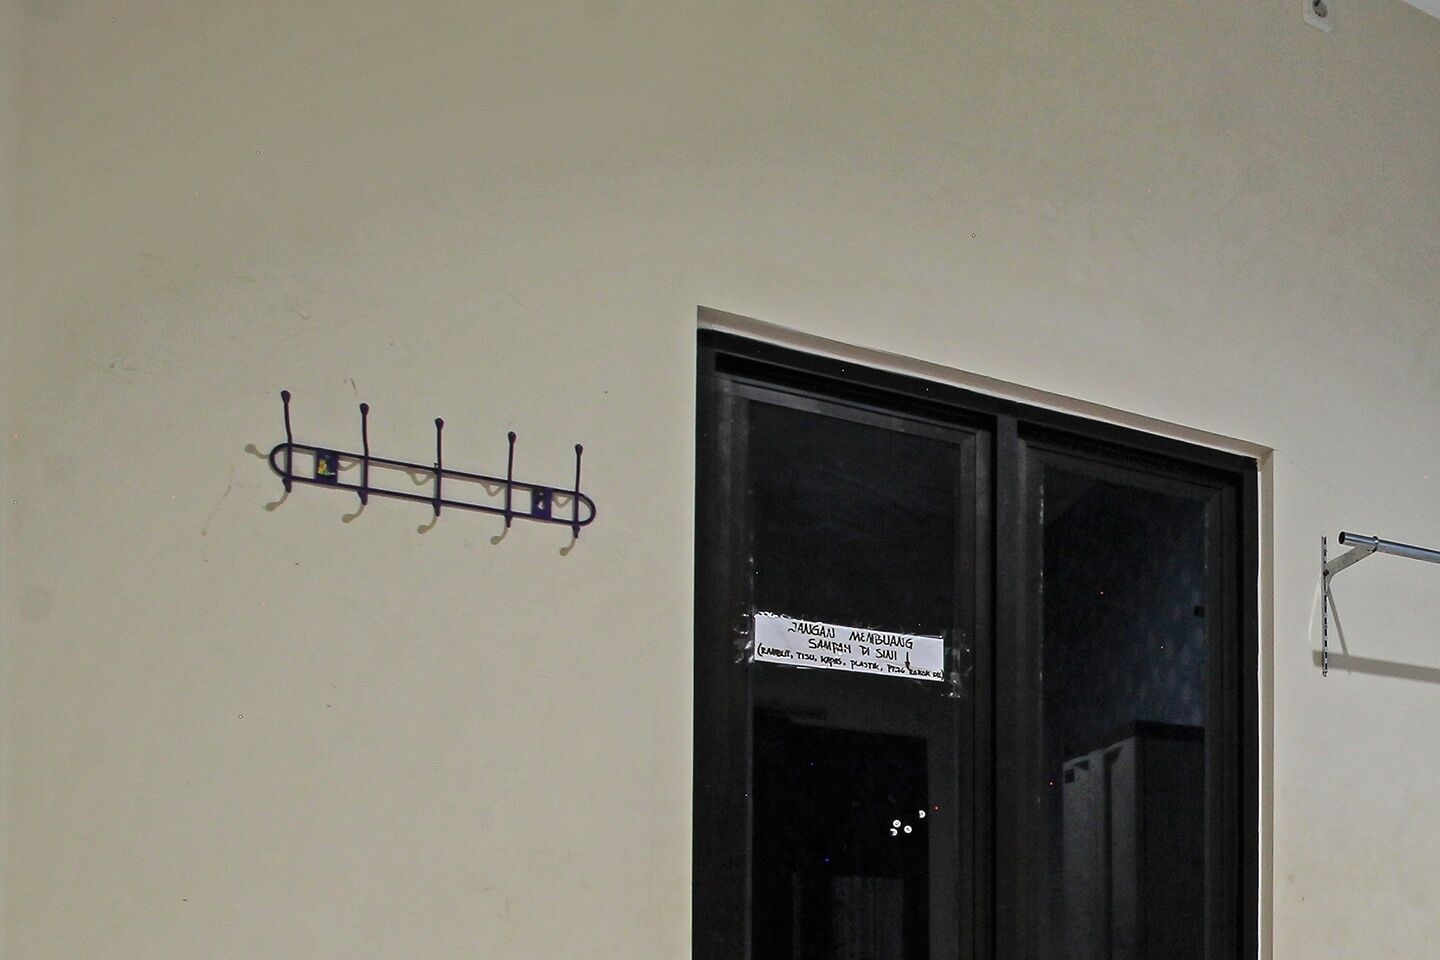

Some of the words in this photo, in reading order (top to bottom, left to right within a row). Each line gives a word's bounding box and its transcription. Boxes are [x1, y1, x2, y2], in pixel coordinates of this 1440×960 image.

[788, 621, 835, 639] JANGAN
[808, 638, 852, 654] SAMPAH
[875, 648, 898, 661] SINI
